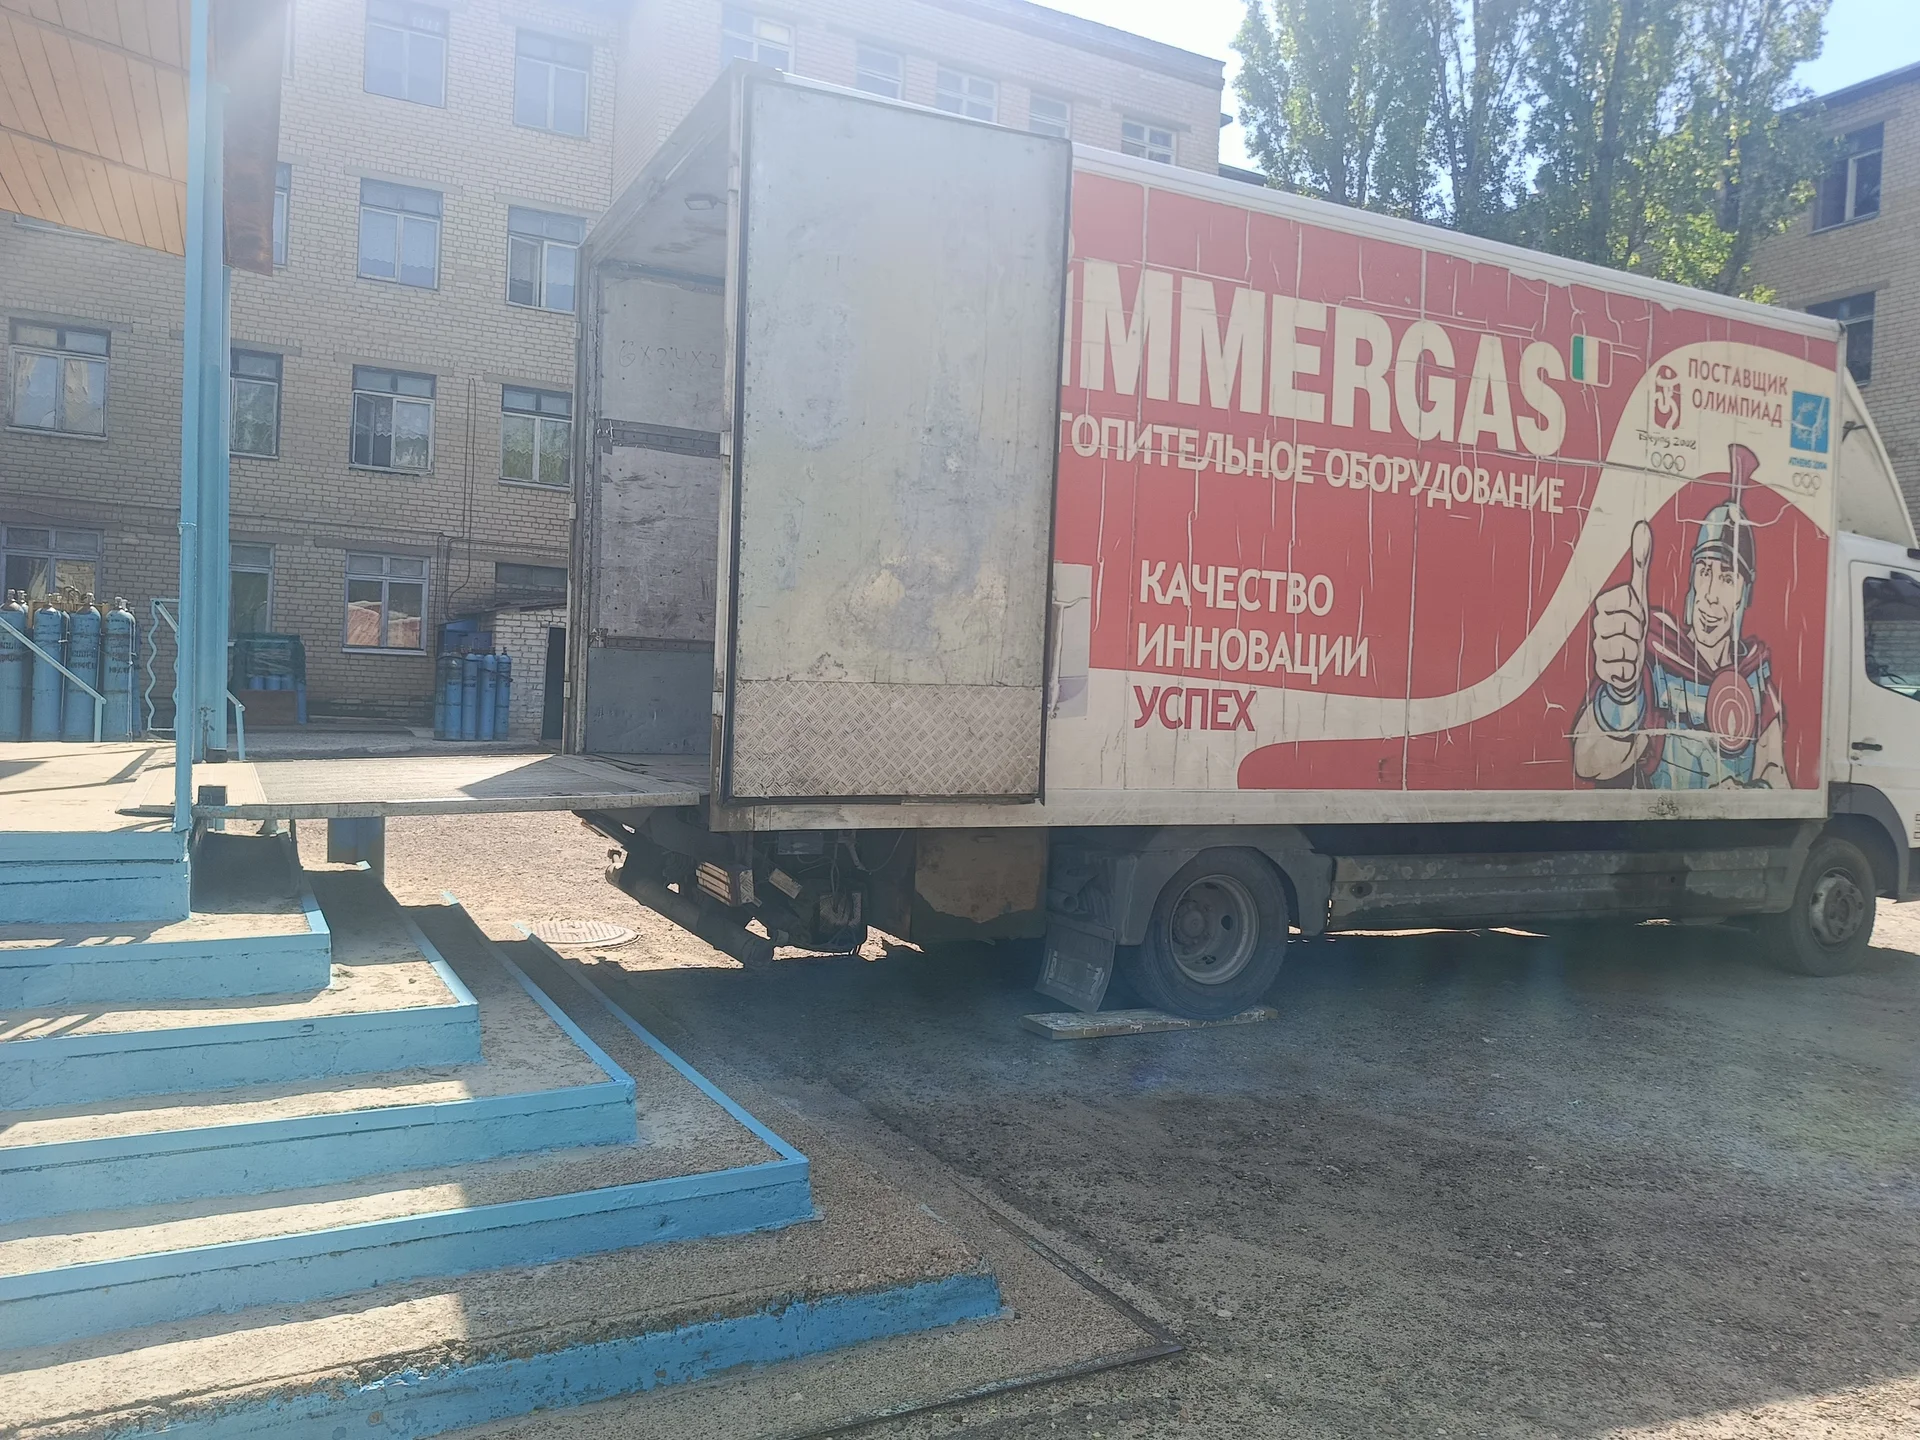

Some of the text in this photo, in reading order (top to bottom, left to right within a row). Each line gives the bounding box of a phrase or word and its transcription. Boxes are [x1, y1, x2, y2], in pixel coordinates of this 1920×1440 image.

[1688, 357, 1788, 397] ПОСТАВЩИК
[1692, 388, 1783, 429] ОЛИМПИАД
[1324, 447, 1565, 515] ОБОРУДОВАНИЕ
[1139, 559, 1335, 617] КАЧЕСТВО
[1136, 622, 1370, 685] ИННОВАЦИИ
[1133, 685, 1257, 732] УСПЕХ
